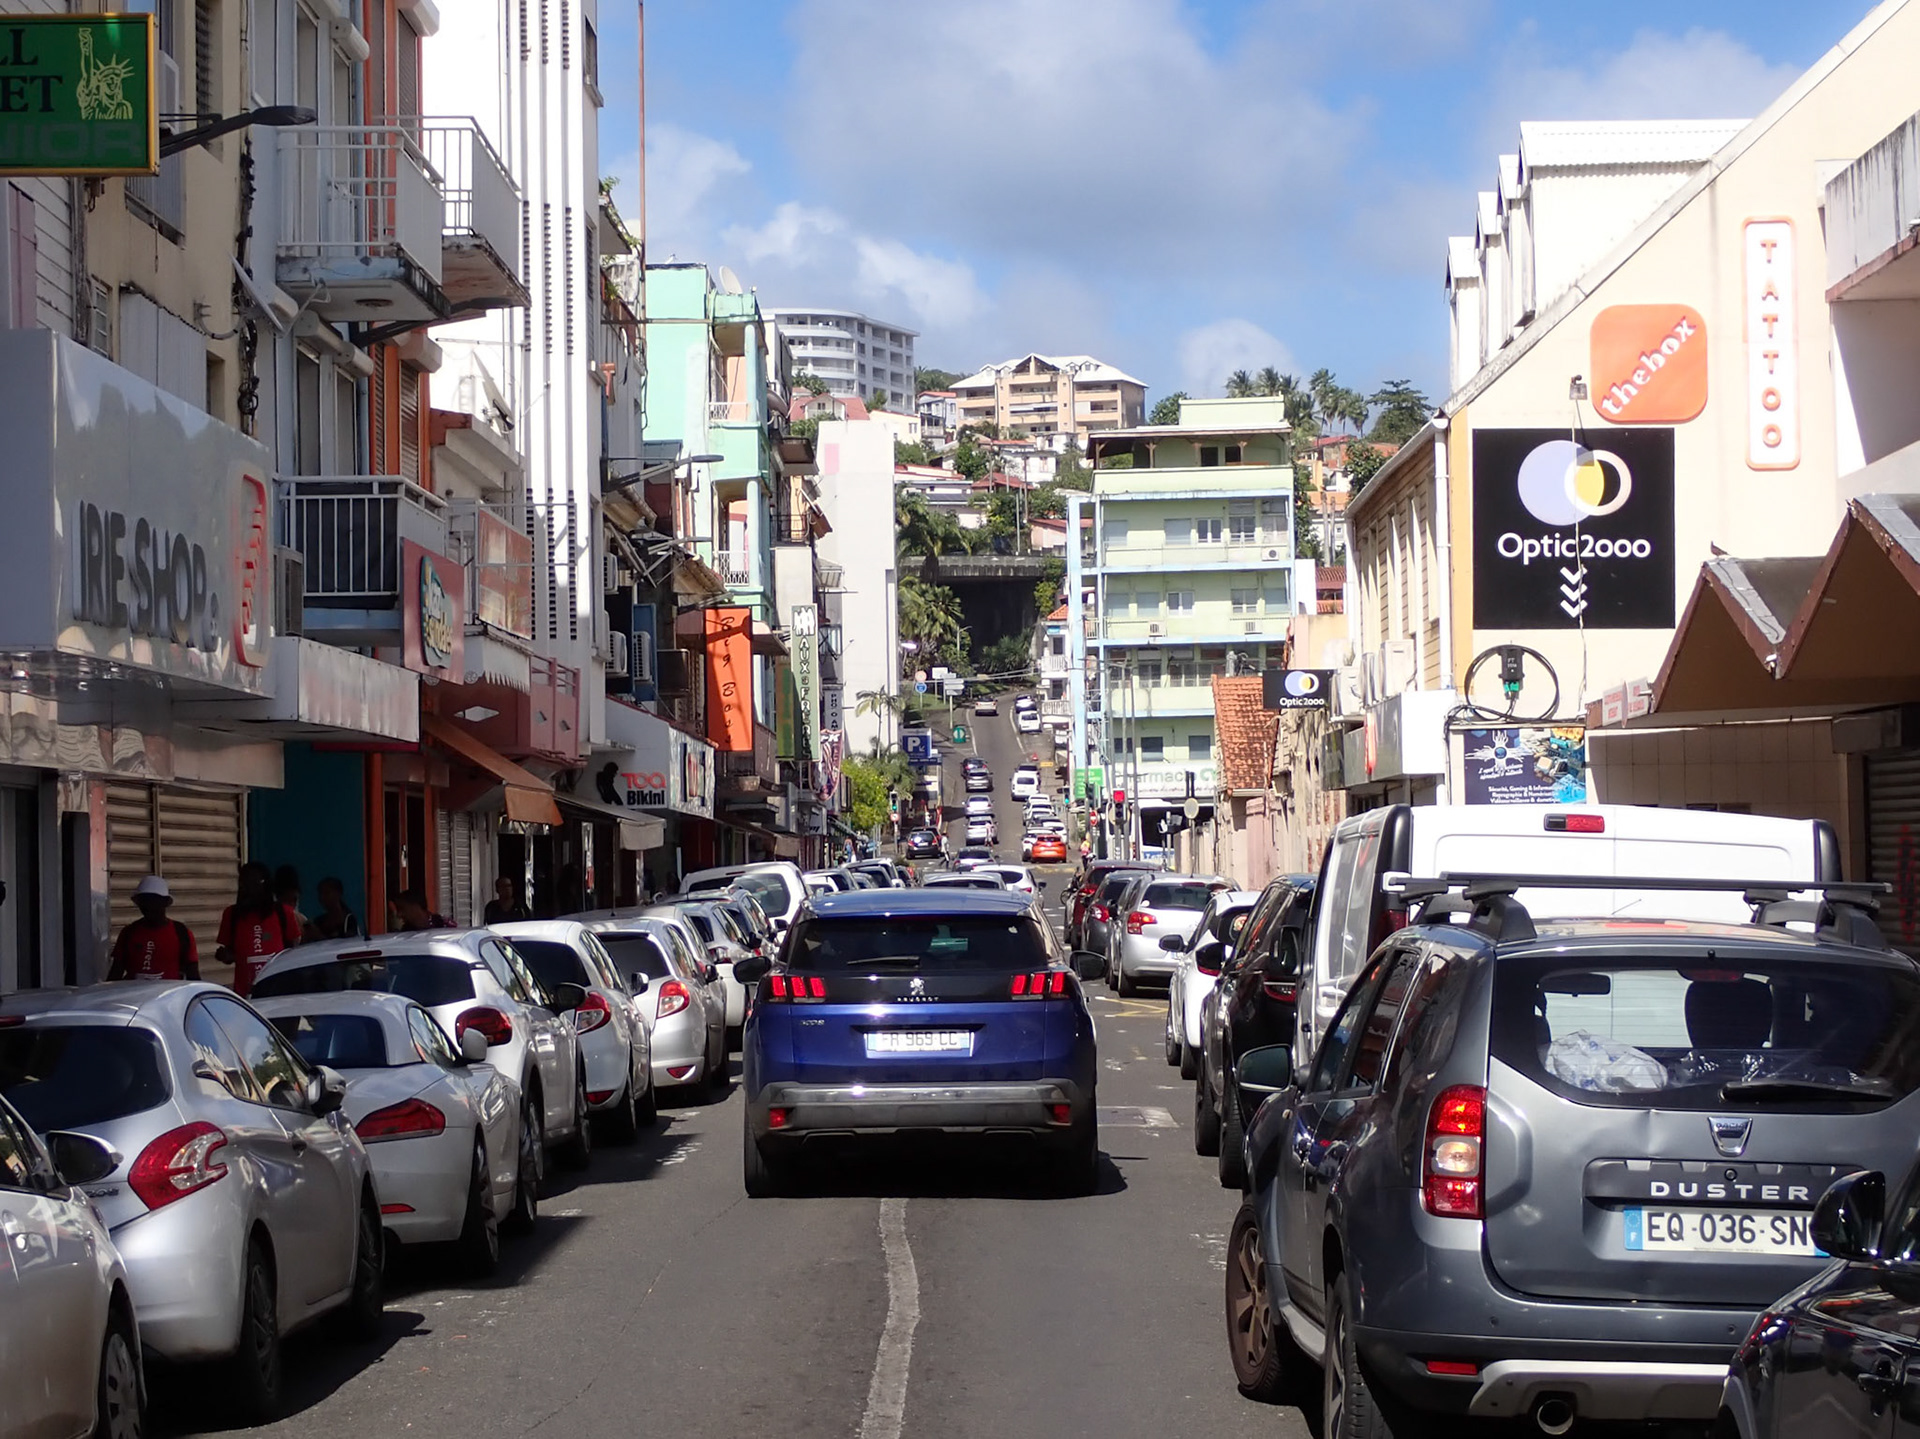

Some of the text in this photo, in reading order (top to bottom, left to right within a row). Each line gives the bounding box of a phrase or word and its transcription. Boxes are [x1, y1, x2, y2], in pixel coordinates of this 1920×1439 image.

[1760, 239, 1782, 448] TATTOO
[1601, 315, 1697, 415] thebox
[907, 737, 921, 752] P
[626, 790, 665, 805] Bikini
[253, 924, 263, 954] direct
[142, 940, 156, 971] direct
[1649, 1180, 1810, 1202] DUSTER
